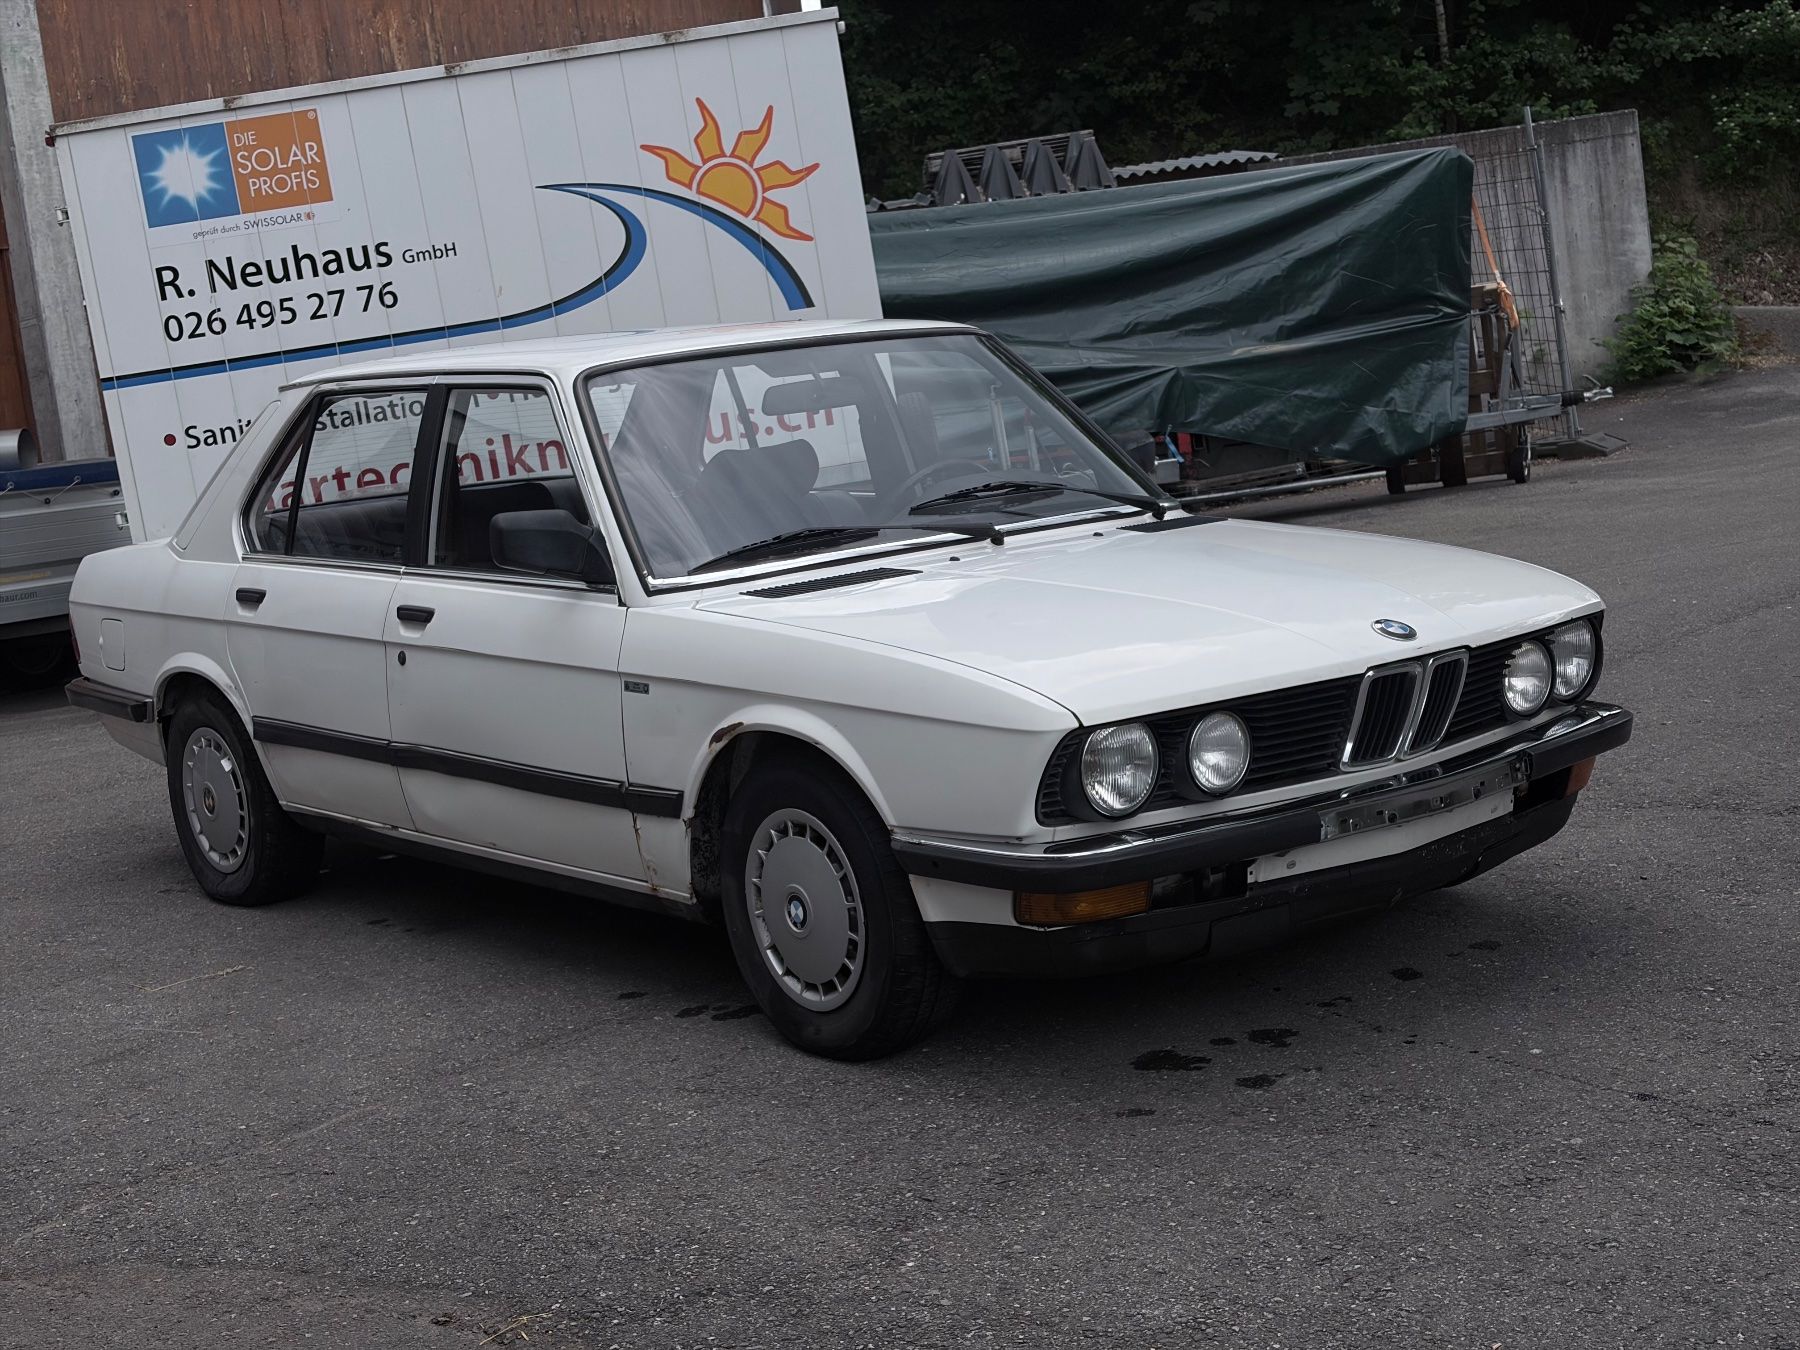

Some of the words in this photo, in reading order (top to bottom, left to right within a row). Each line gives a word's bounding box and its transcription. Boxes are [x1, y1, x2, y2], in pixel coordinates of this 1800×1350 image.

[233, 131, 258, 148] DIE
[236, 141, 321, 175] SOLAR
[248, 169, 320, 198] PROFIS
[192, 226, 219, 239] geprüft
[220, 222, 241, 235] durch
[243, 212, 304, 231] SWISSOLAR
[155, 265, 196, 301] R.
[205, 241, 393, 294] Neuhaus
[402, 242, 457, 264] GmbH
[163, 308, 227, 342] 026
[236, 297, 297, 330] 495
[309, 289, 346, 321] 27
[356, 281, 399, 312] 76
[184, 418, 251, 450] Sani
[315, 396, 424, 432] stallatio
